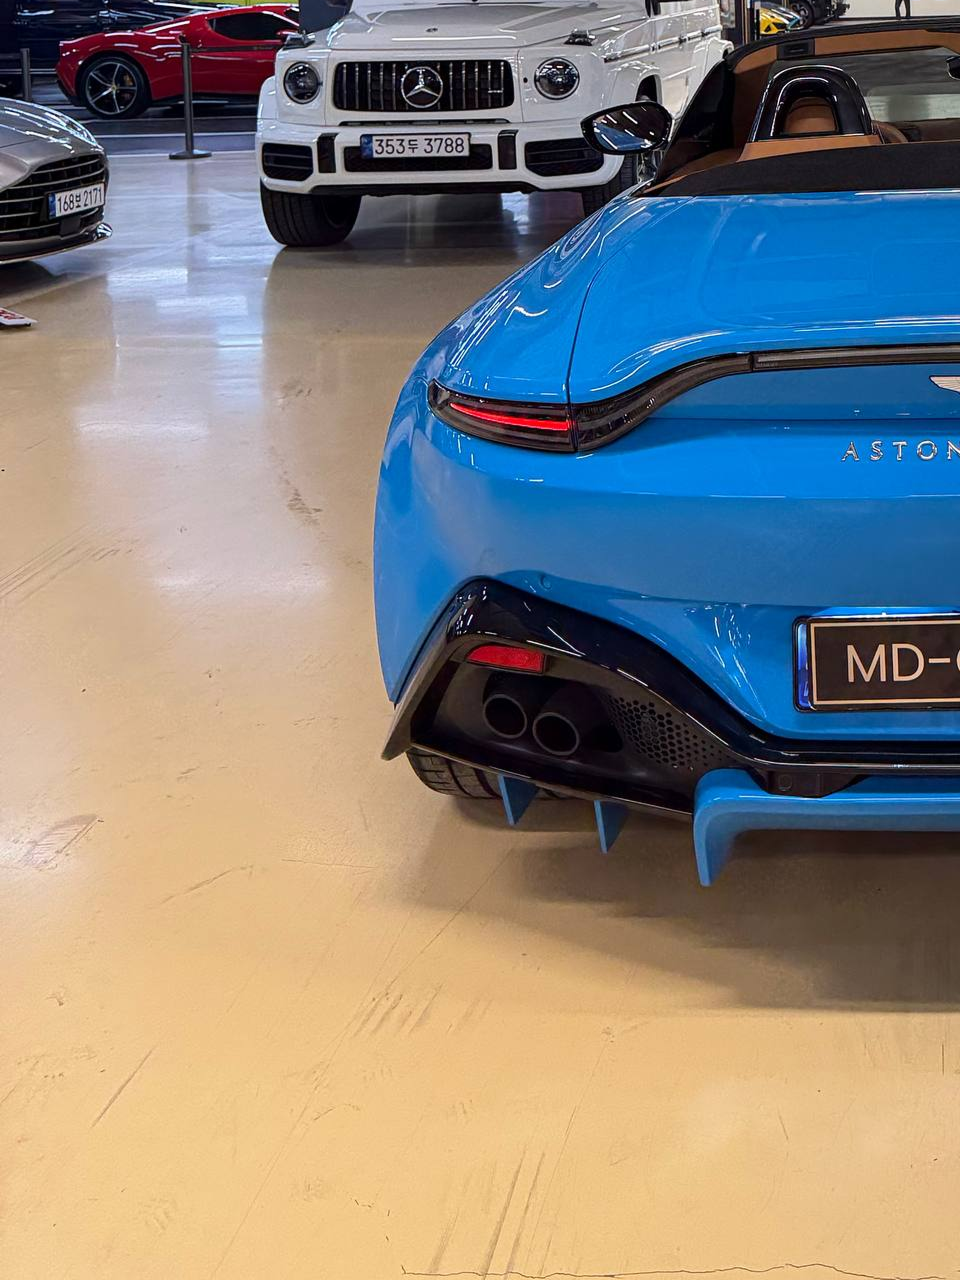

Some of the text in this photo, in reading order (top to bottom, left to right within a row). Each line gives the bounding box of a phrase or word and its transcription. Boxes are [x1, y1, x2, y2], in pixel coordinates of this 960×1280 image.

[375, 137, 465, 155] 353두 3788
[57, 186, 103, 212] 168보 2171
